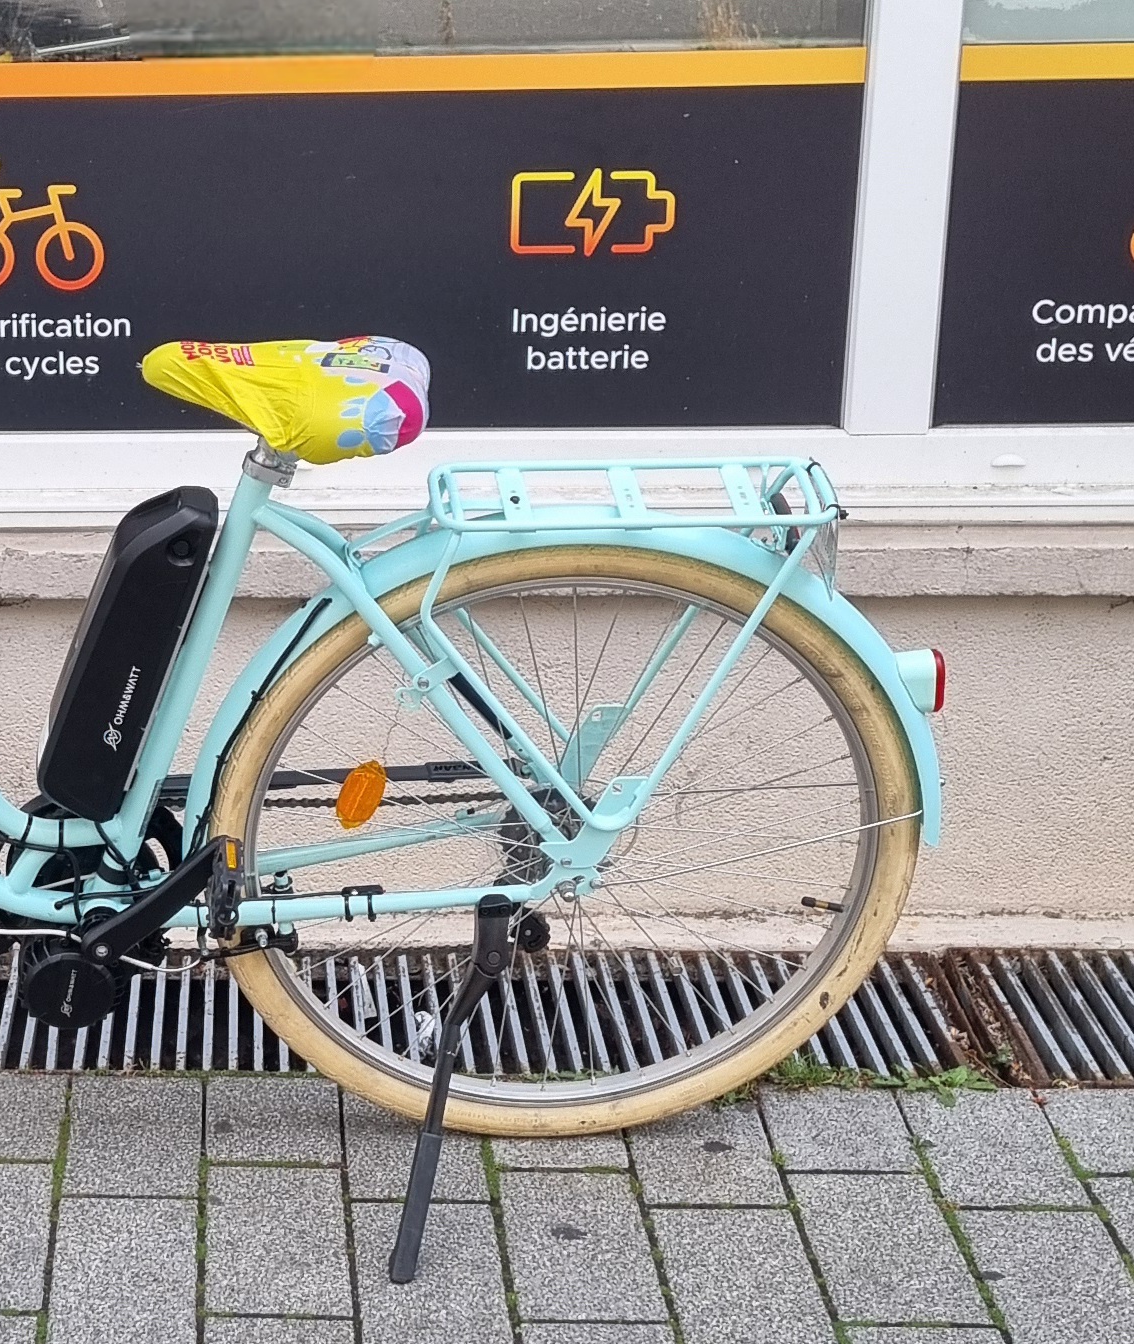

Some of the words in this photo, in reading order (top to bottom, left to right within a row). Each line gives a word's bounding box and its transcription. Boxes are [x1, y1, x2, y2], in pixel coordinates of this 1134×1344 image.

[512, 306, 667, 338] Ingénierie
[5, 350, 101, 381] cycles
[526, 344, 650, 370] batterie
[1036, 337, 1094, 363] des
[113, 665, 142, 725] OHM&WATT
